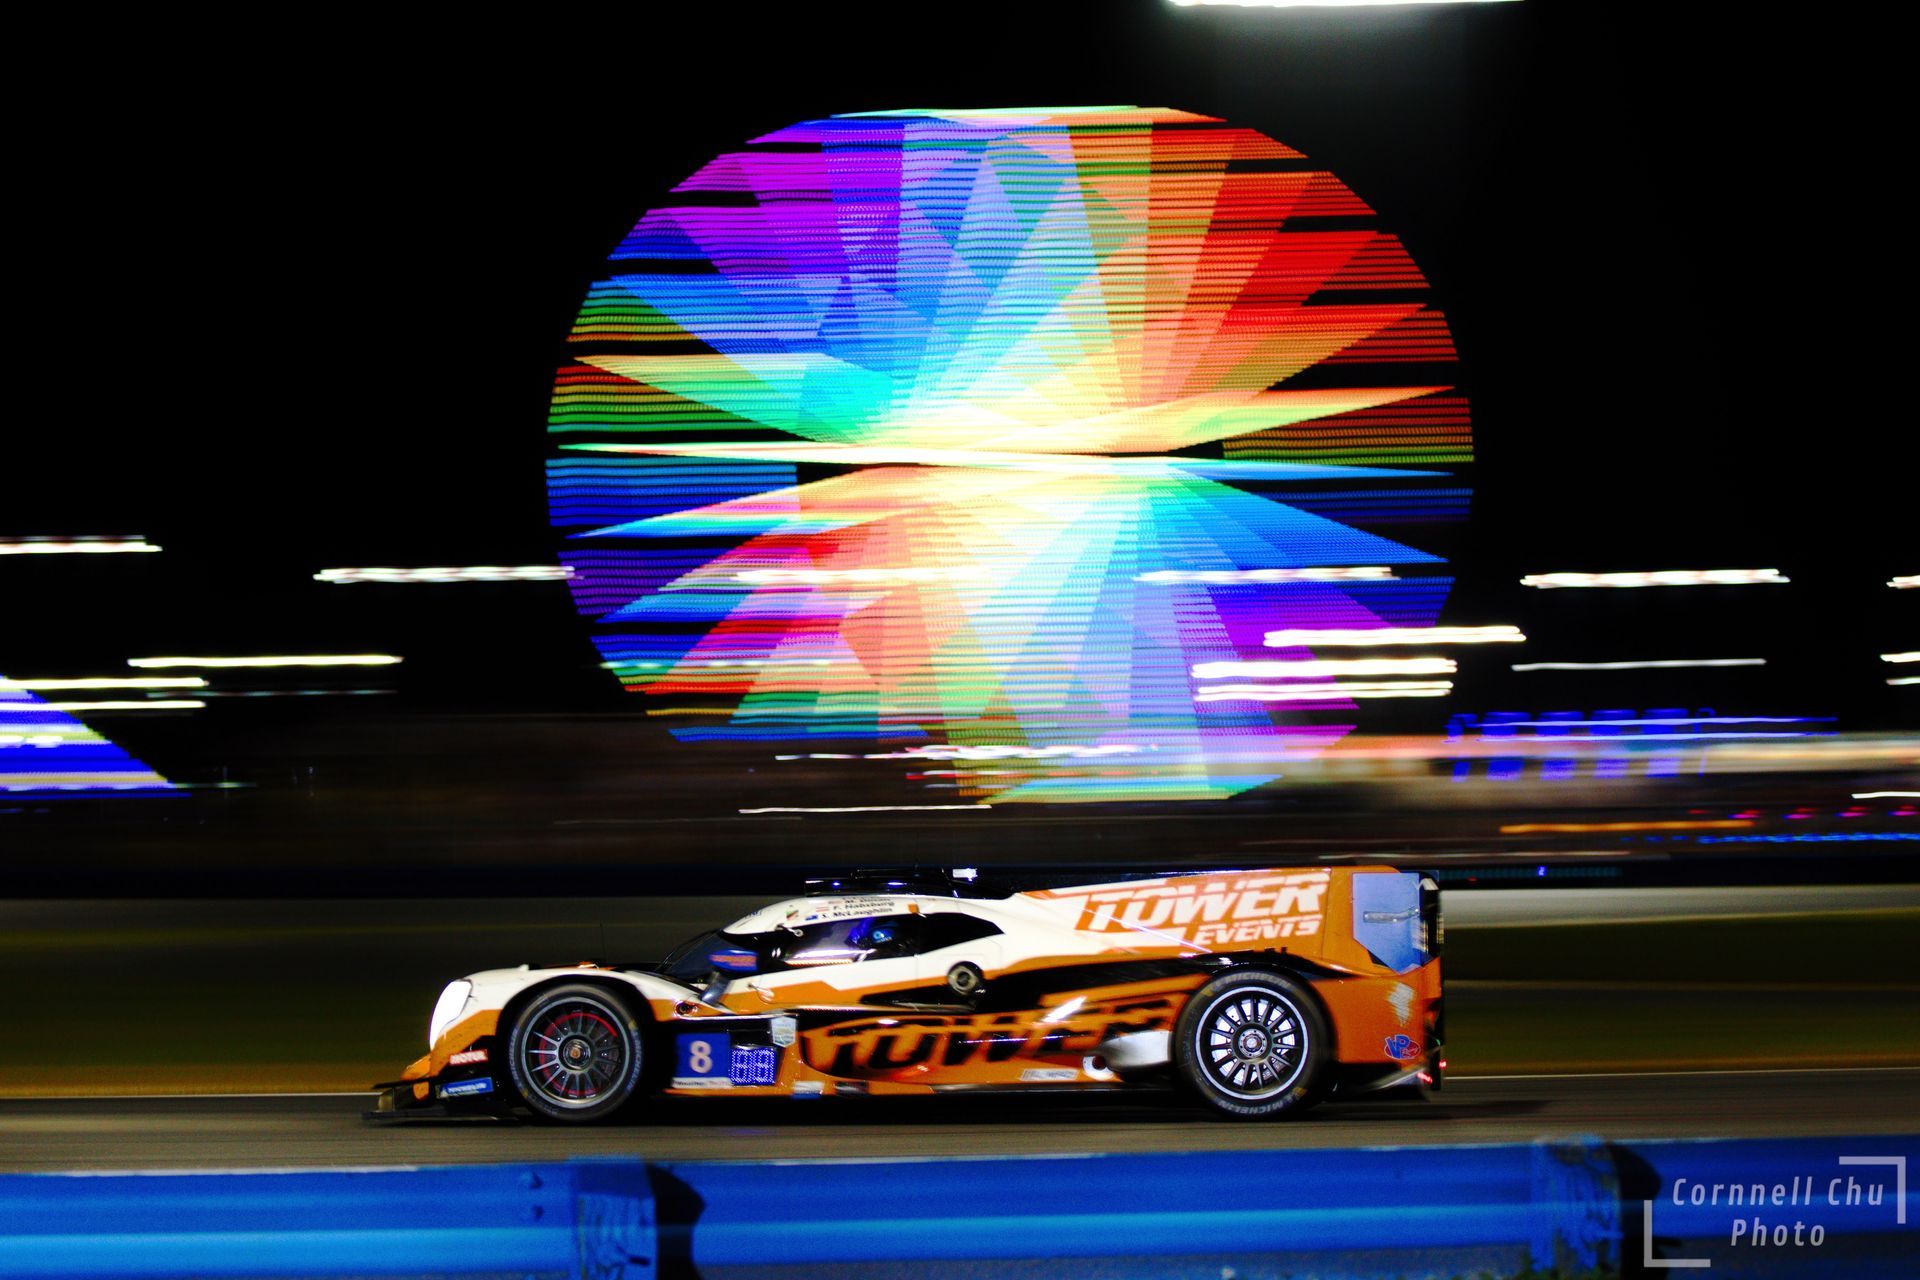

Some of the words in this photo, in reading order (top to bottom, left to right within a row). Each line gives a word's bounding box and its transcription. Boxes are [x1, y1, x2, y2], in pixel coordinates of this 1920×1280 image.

[1088, 872, 1330, 931] TOWER
[1193, 914, 1323, 945] EVENTS
[689, 1040, 713, 1074] 8
[1216, 1097, 1285, 1114] MICHELIN
